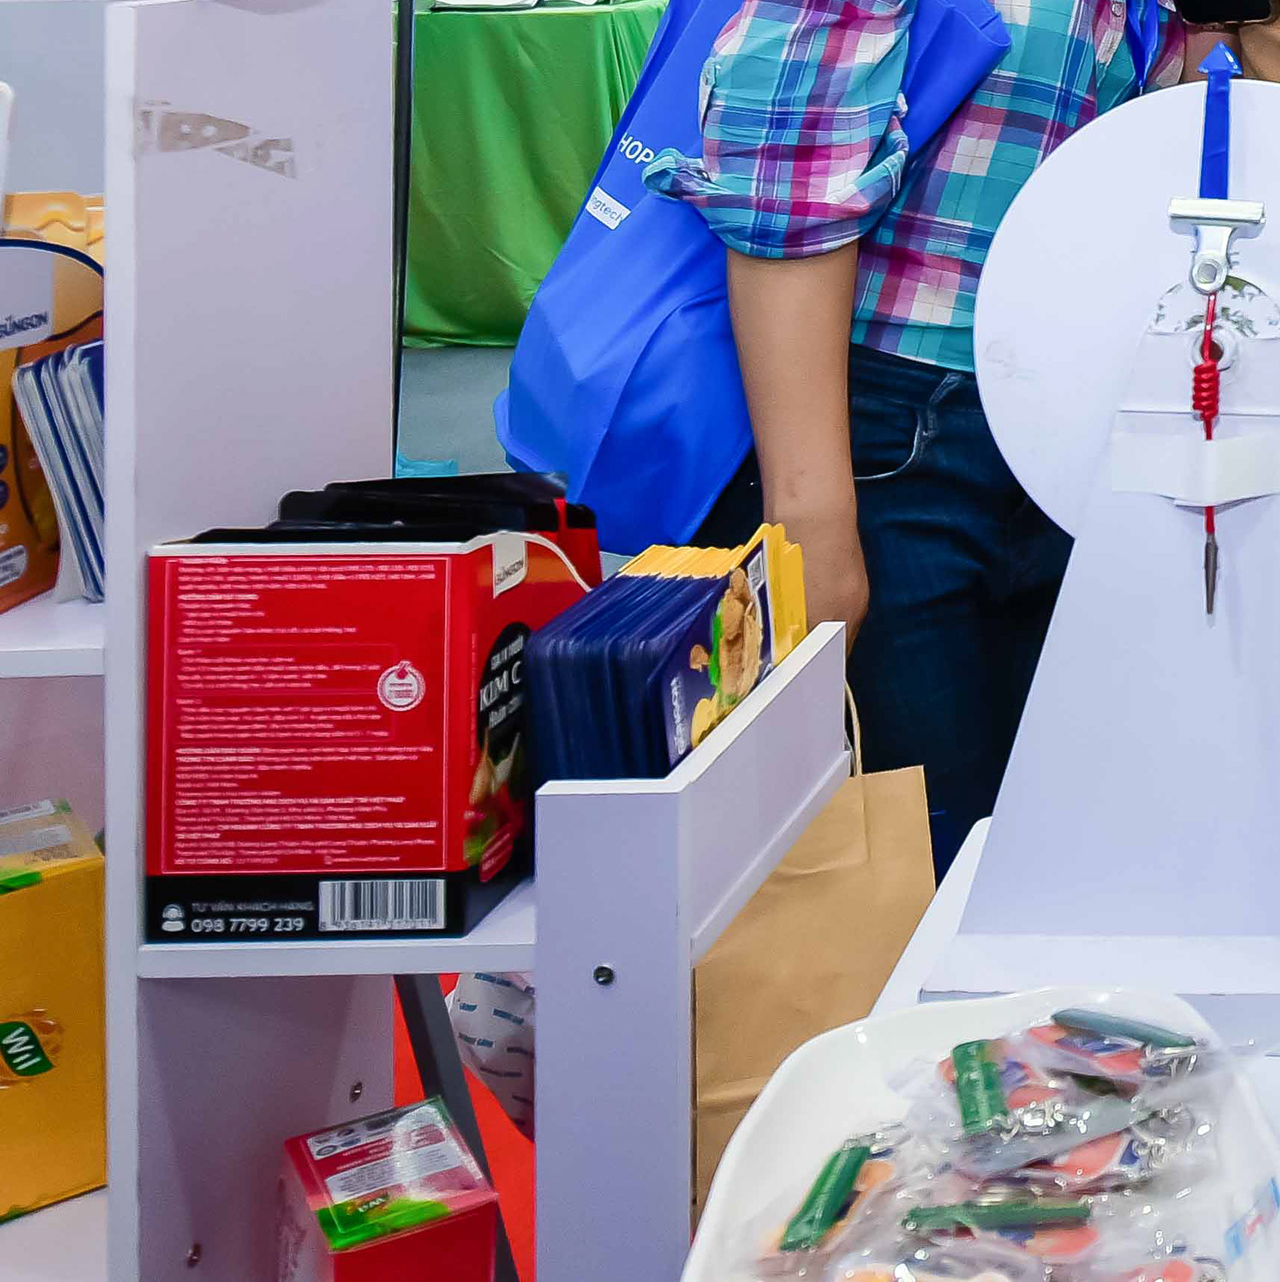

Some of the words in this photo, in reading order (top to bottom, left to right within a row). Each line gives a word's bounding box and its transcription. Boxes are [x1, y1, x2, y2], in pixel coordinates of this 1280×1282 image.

[190, 919, 224, 933] 098
[229, 919, 270, 932] 7799
[273, 918, 304, 932] 239
